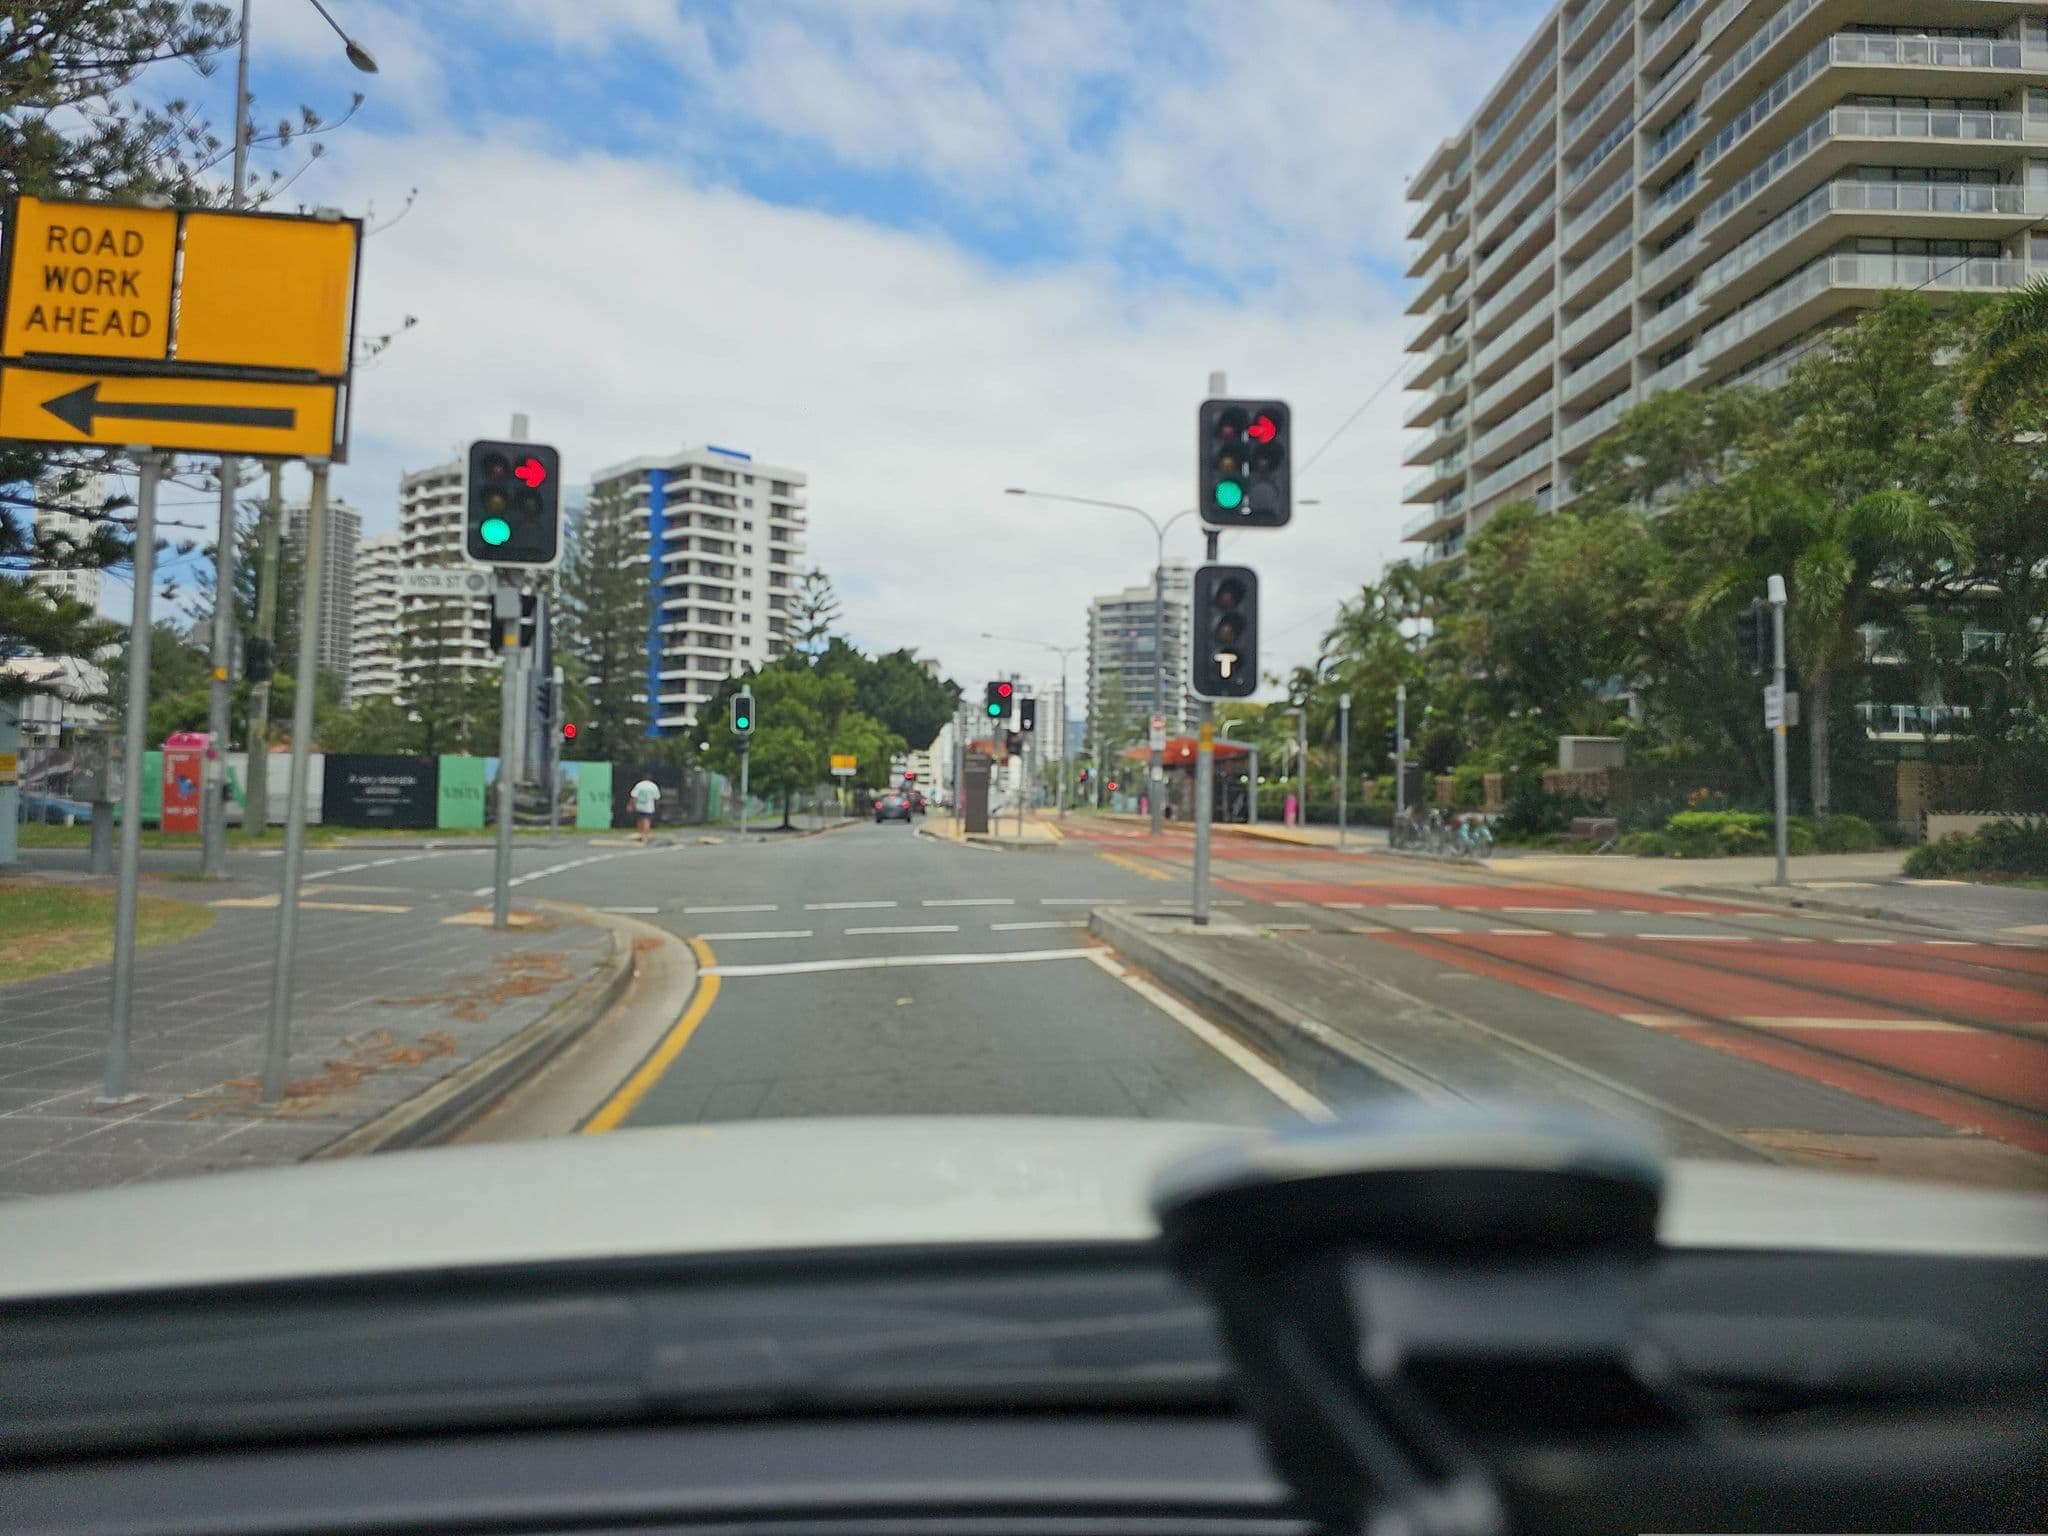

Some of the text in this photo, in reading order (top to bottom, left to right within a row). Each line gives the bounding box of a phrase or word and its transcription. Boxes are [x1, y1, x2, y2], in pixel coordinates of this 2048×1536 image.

[47, 224, 145, 258] ROAD
[43, 265, 140, 298] WORK
[25, 304, 151, 338] AHEAD
